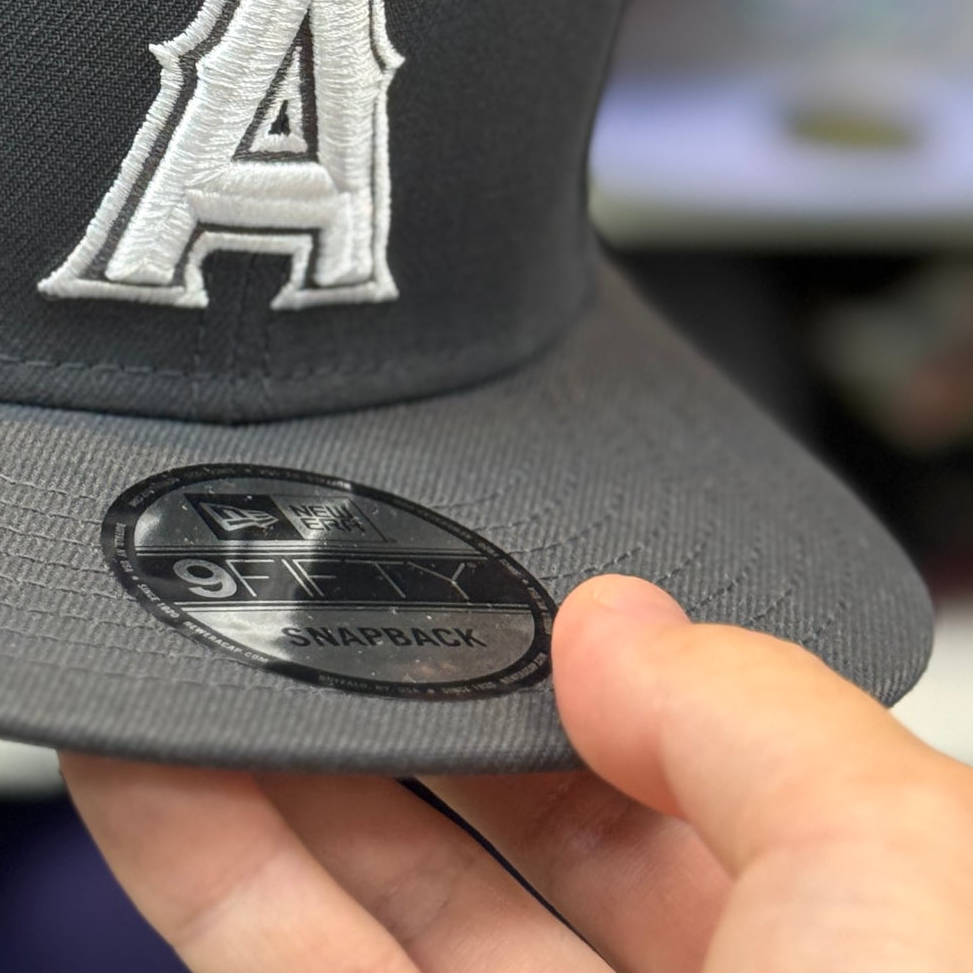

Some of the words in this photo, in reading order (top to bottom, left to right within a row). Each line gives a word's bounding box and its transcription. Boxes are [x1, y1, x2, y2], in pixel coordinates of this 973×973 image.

[289, 504, 355, 520] NEW
[300, 517, 367, 533] ERA
[172, 558, 471, 601] 9FIFTY
[282, 627, 488, 647] SNAPBACK
